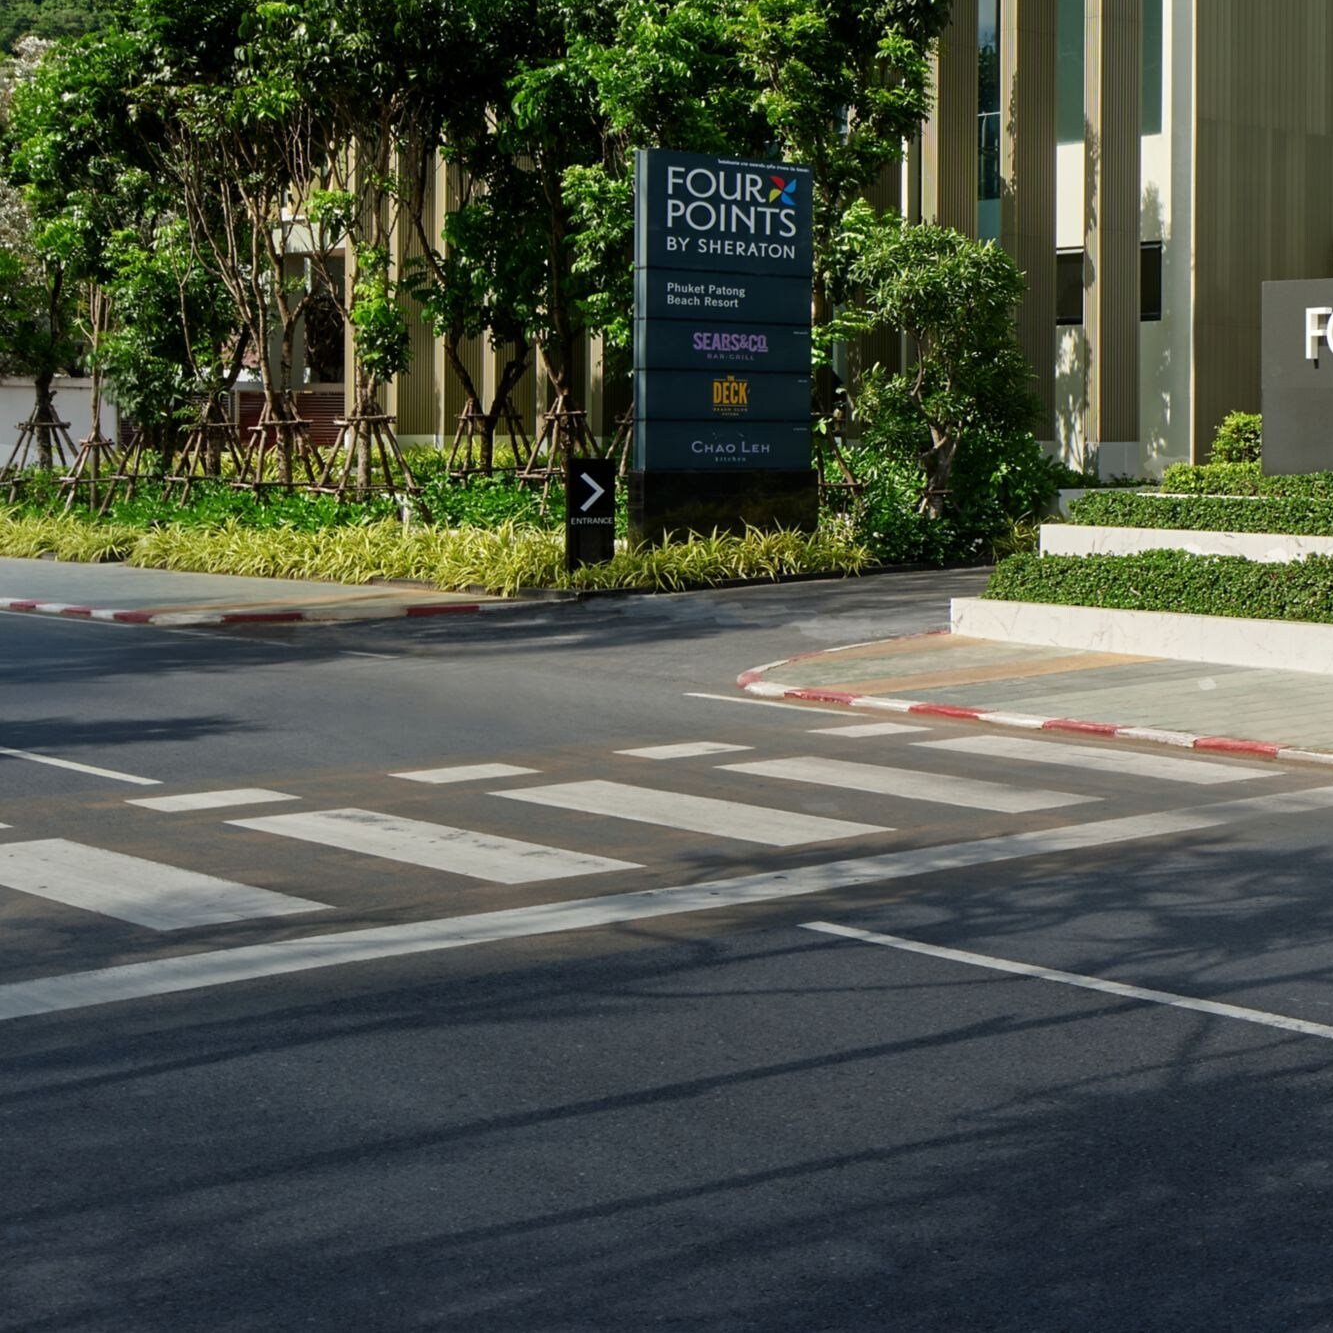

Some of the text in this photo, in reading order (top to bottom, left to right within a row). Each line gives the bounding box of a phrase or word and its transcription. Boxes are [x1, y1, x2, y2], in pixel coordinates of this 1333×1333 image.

[667, 166, 767, 203] FOUR
[667, 199, 797, 238] POINTS
[667, 236, 796, 259] BY SHERATON
[667, 282, 746, 298] Phuket Patong
[667, 295, 739, 308] Beach Resort
[713, 381, 748, 404] DECK
[570, 517, 613, 525] ENTRANCE
